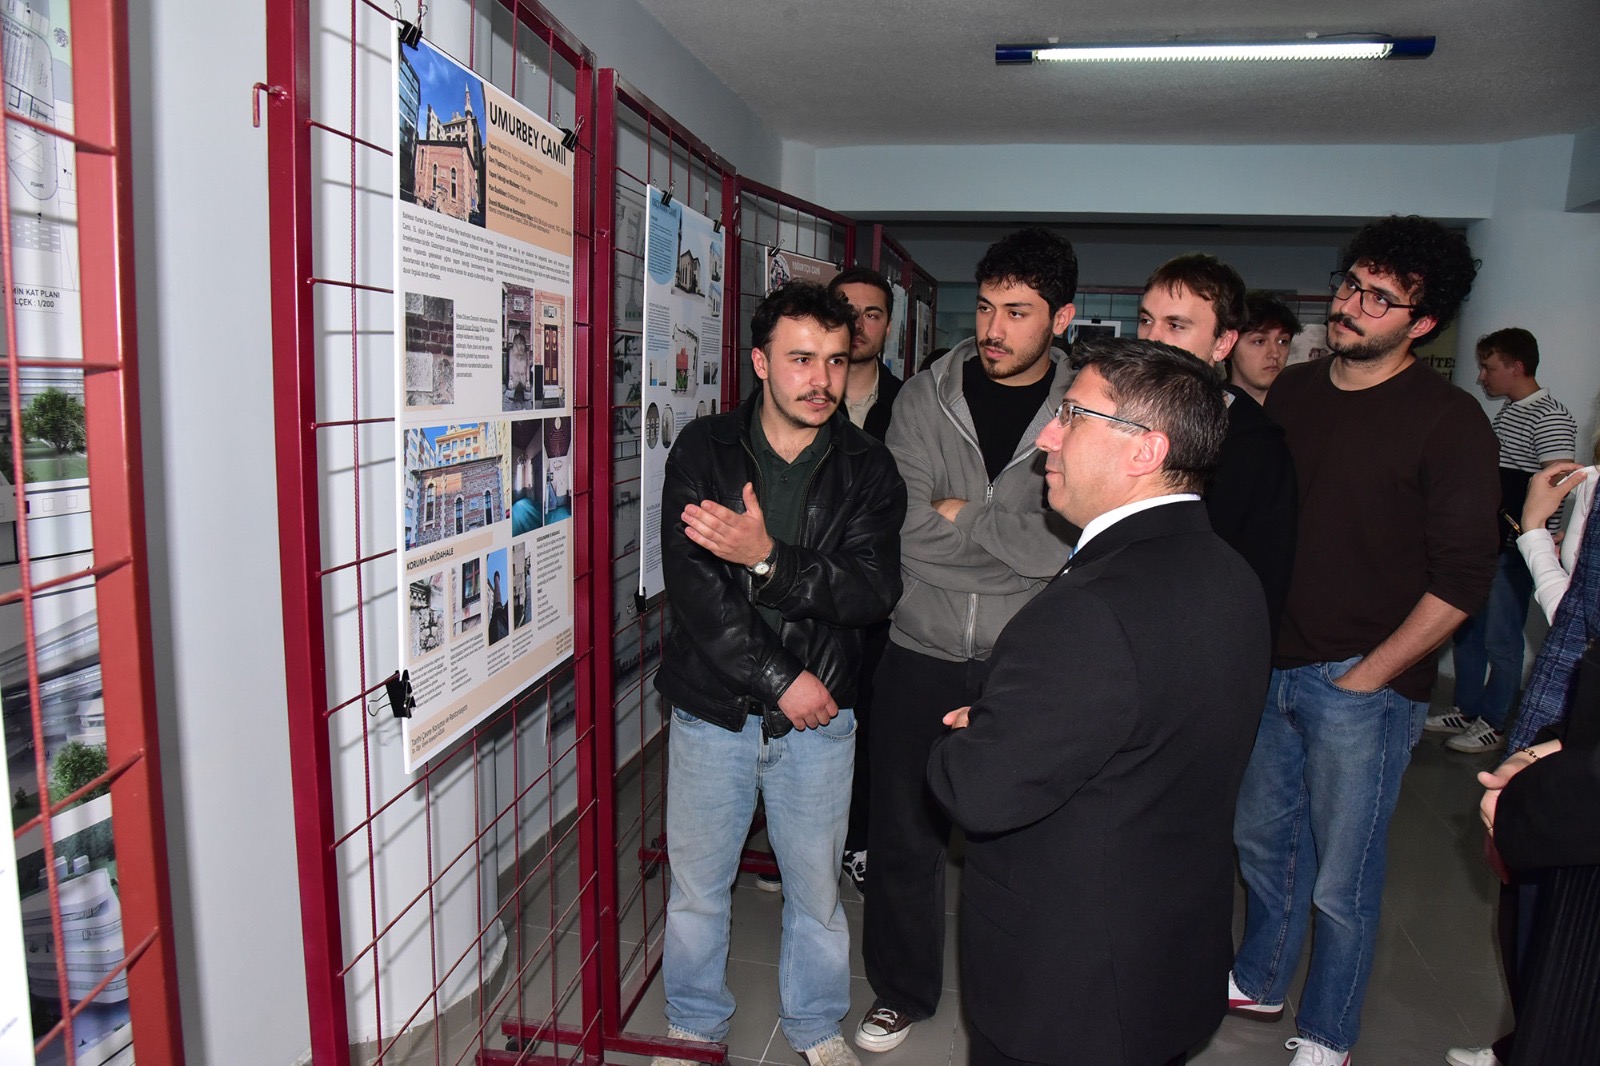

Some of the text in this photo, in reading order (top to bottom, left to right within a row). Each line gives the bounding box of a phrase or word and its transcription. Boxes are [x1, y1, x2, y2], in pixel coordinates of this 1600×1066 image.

[489, 101, 540, 149] UMURBEY
[40, 290, 60, 298] PLANI
[38, 300, 54, 308] 1/200
[406, 547, 454, 570] KORUMA-MÜDAHALE
